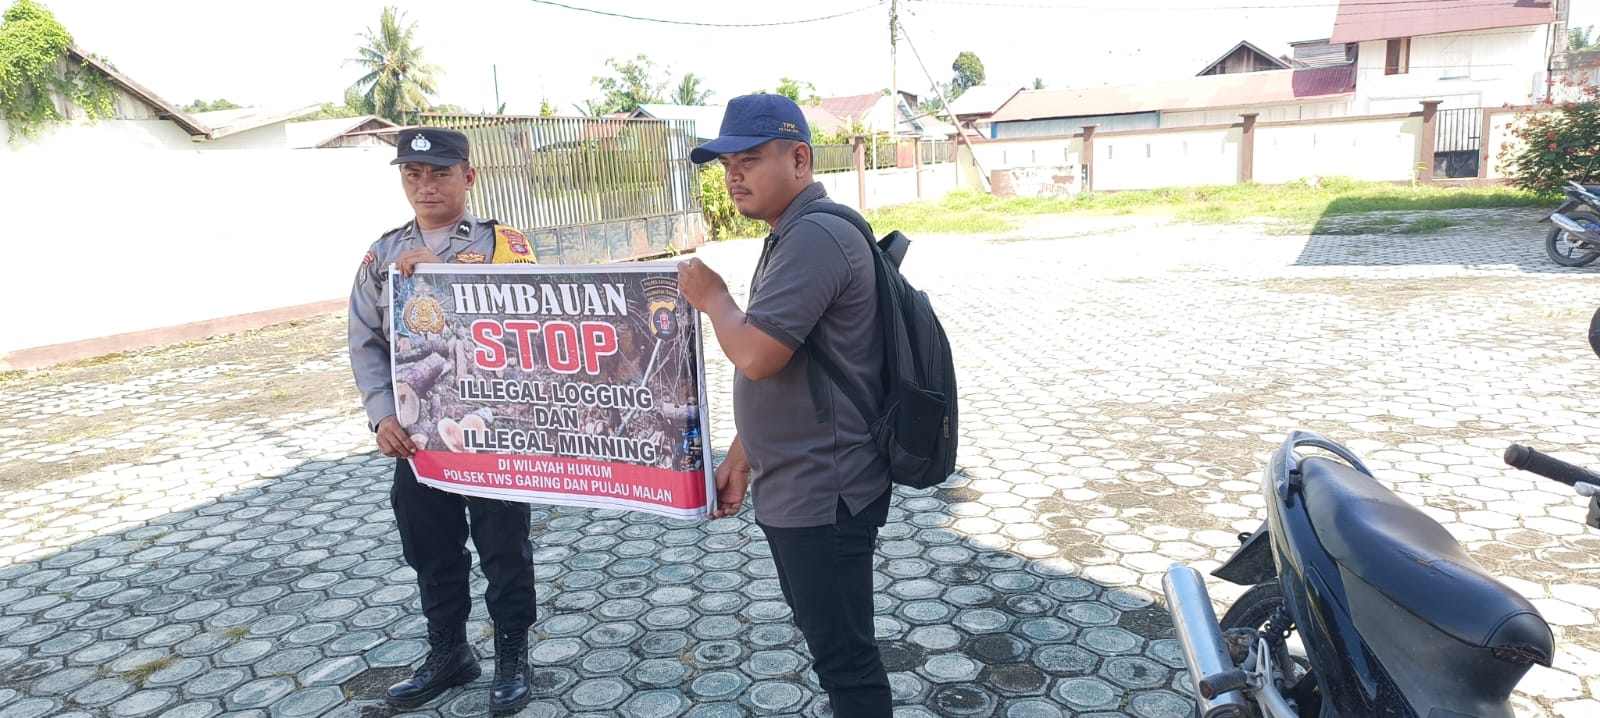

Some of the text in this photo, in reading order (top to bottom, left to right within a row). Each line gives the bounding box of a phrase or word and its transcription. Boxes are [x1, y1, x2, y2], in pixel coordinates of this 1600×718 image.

[451, 283, 628, 316] HIMBAUAN
[471, 319, 618, 375] STOP
[459, 379, 654, 411] ILLEGAL LOGGING
[534, 406, 579, 431] DAN
[463, 428, 656, 463] ILLEGAL MINNING
[498, 458, 613, 479] DI WILAYAH HUKUM
[443, 469, 673, 503] POLSEK TWS GARING DAN PULAU MALAN
